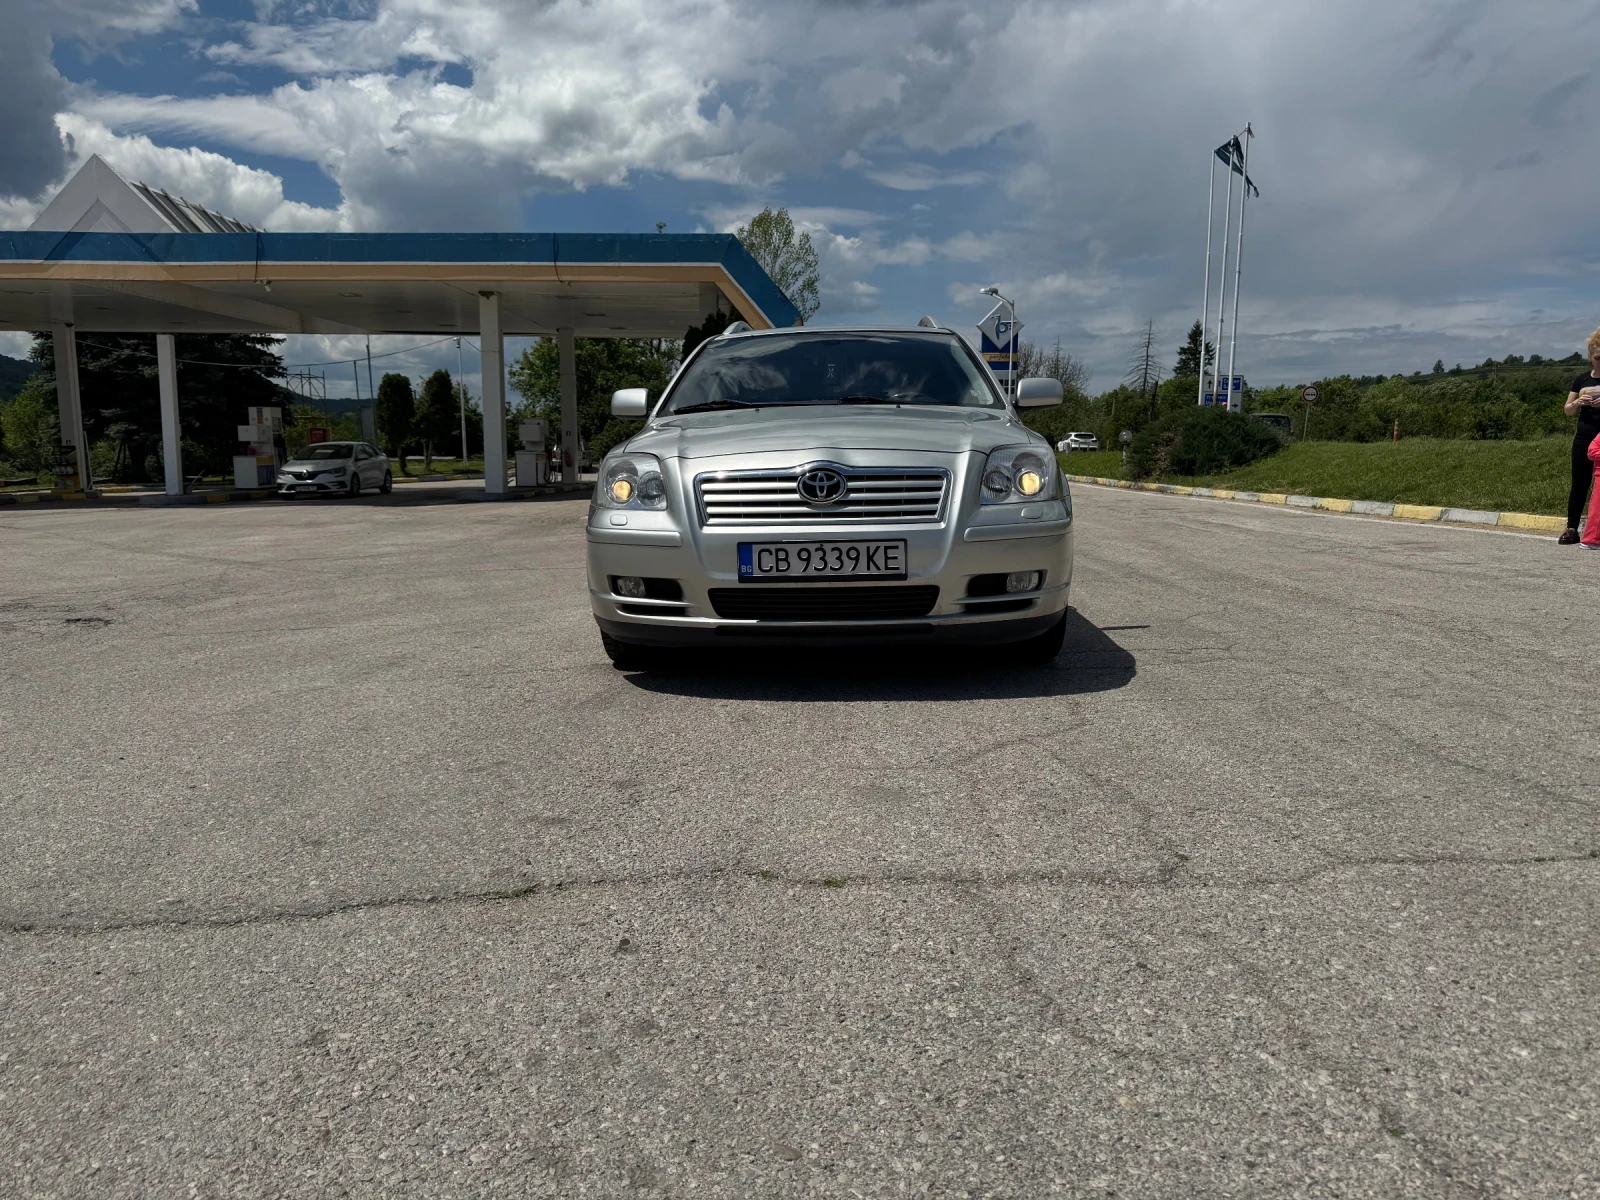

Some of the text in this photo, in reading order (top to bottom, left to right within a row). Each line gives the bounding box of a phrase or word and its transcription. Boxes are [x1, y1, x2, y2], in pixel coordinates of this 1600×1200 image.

[757, 545, 900, 573] CB 9339 KE
[741, 565, 752, 573] BG
